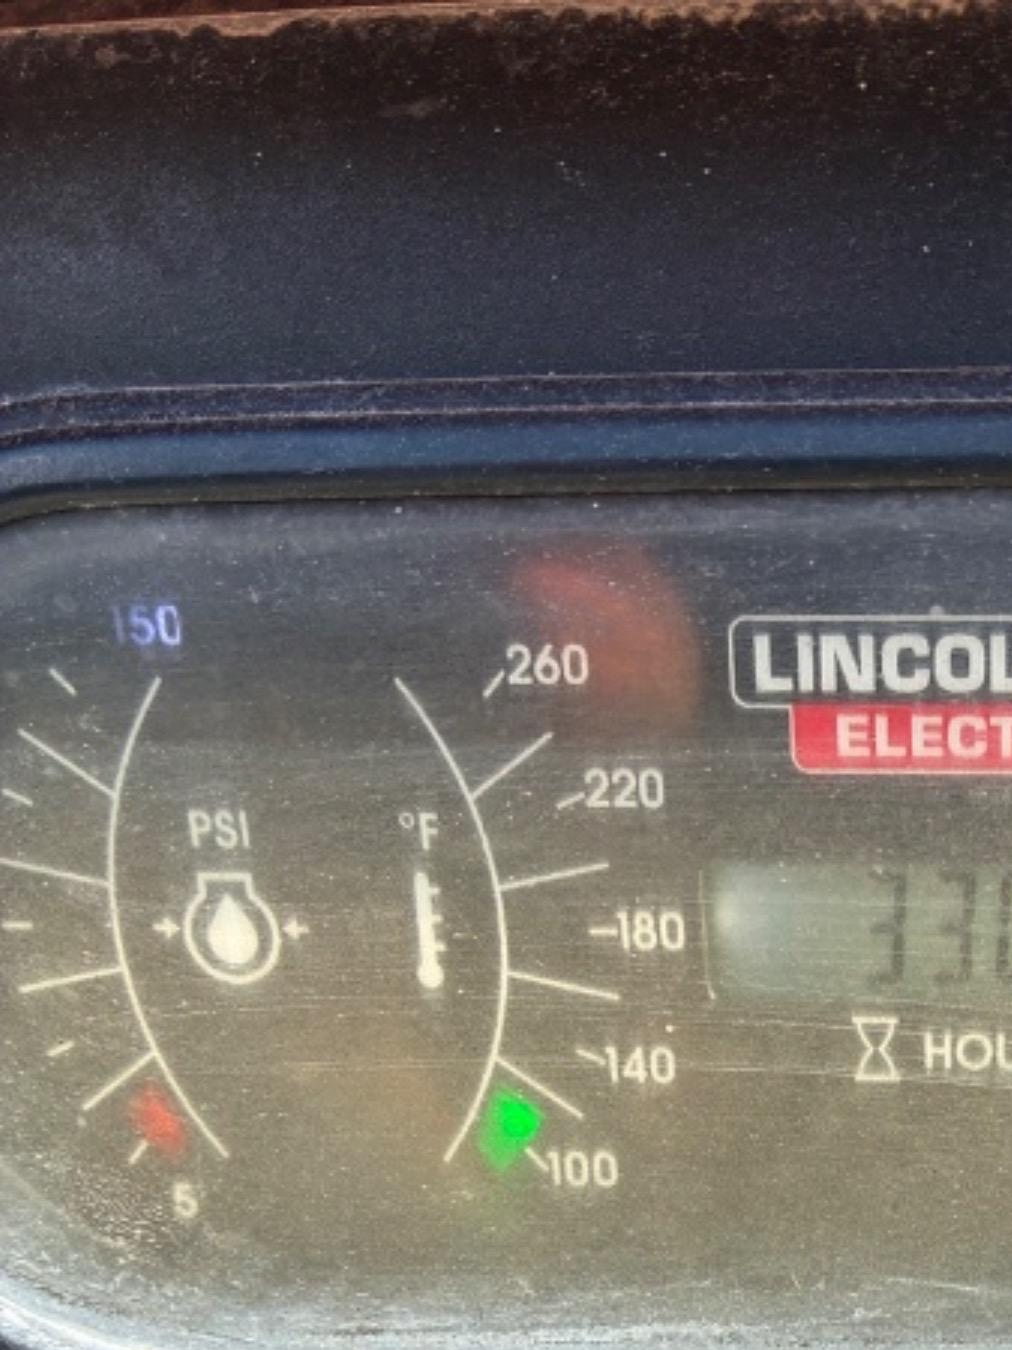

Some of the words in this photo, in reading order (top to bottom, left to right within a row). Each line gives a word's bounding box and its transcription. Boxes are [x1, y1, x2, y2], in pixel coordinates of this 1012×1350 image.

[109, 604, 182, 646] 150
[505, 643, 589, 687] 260
[583, 768, 664, 810] 220
[187, 810, 250, 849] PSI
[616, 910, 685, 951] 180
[605, 1046, 676, 1086] 140
[547, 1150, 619, 1189] 100
[173, 1180, 199, 1218] 5
